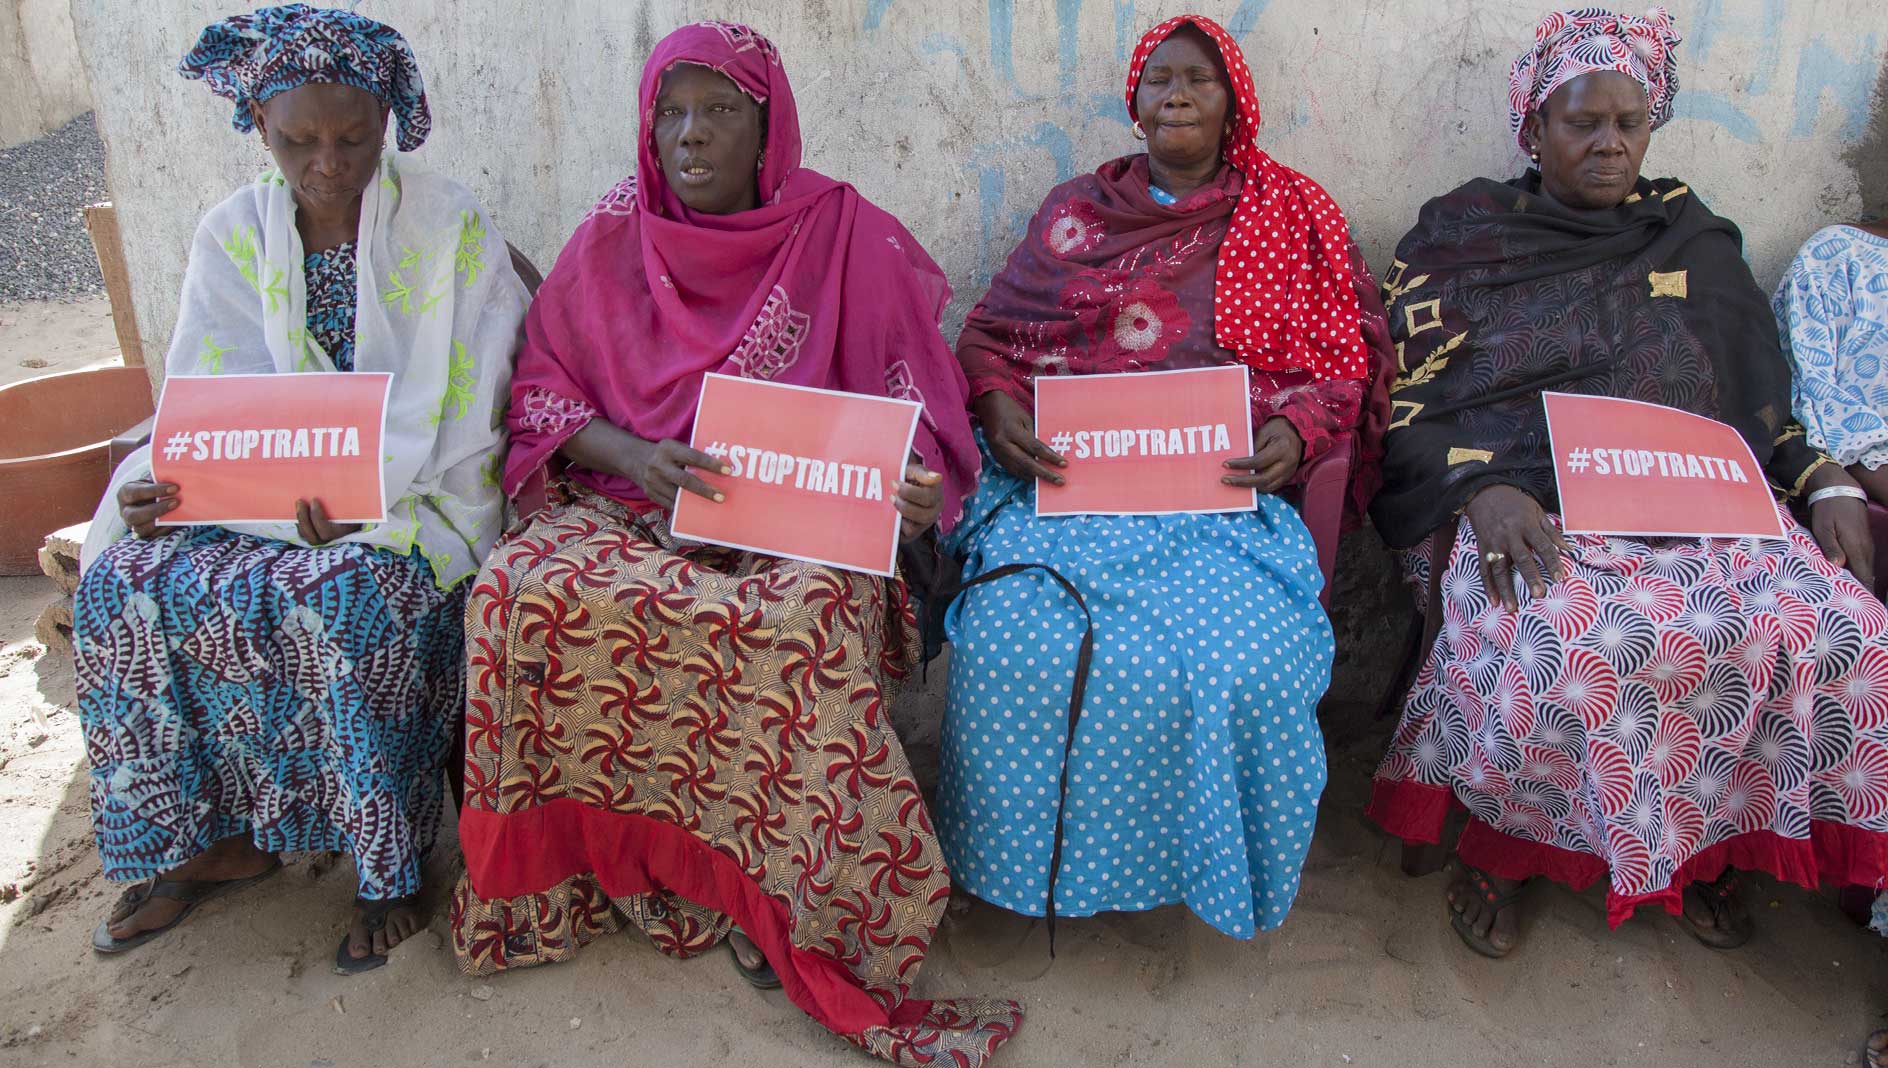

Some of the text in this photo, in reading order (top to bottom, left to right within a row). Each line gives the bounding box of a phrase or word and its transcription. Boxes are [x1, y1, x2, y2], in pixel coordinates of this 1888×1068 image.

[163, 426, 361, 461] #STOPTRATTA
[1050, 424, 1231, 459] #STOPTRATTA
[704, 441, 883, 501] #STOPTRATTA
[1567, 447, 1748, 483] #STOPTRATTA
